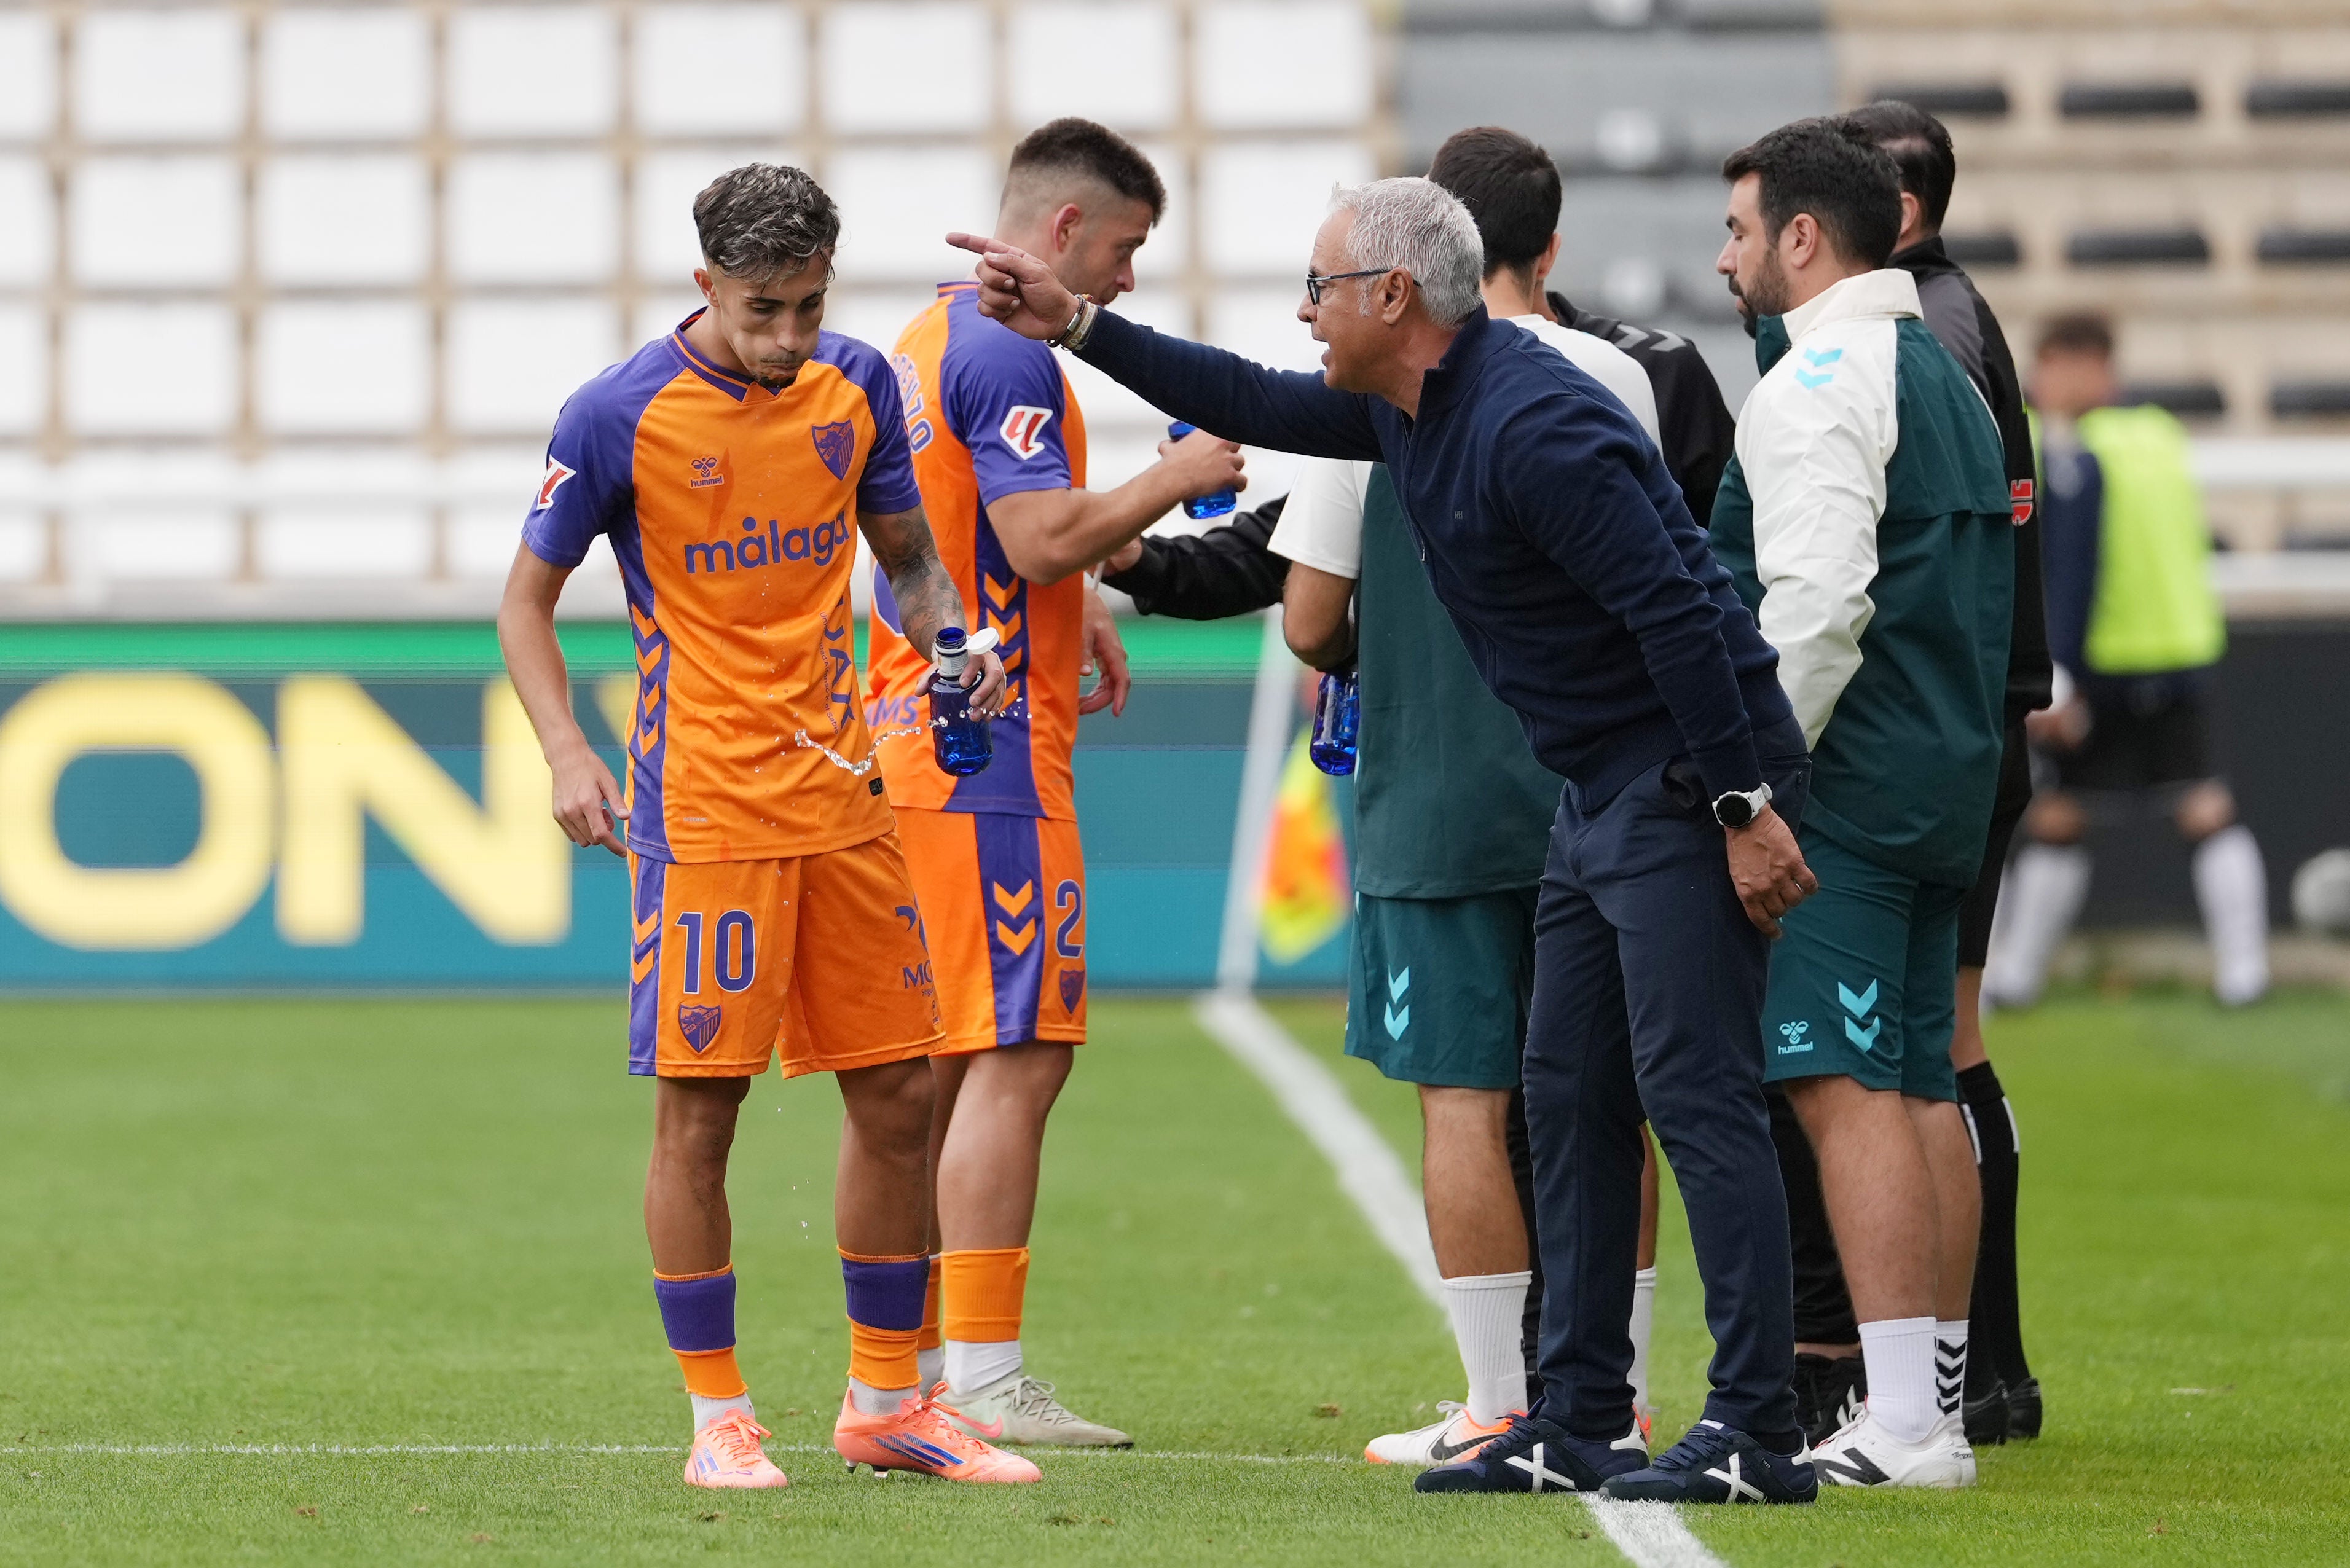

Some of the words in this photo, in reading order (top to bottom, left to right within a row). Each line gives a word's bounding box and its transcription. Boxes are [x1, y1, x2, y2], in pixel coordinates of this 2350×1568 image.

[690, 476, 723, 487] hummel
[0, 668, 637, 951] ON
[675, 909, 756, 995] 10
[1056, 879, 1083, 958] 2
[1778, 1041, 1813, 1054] hummel
